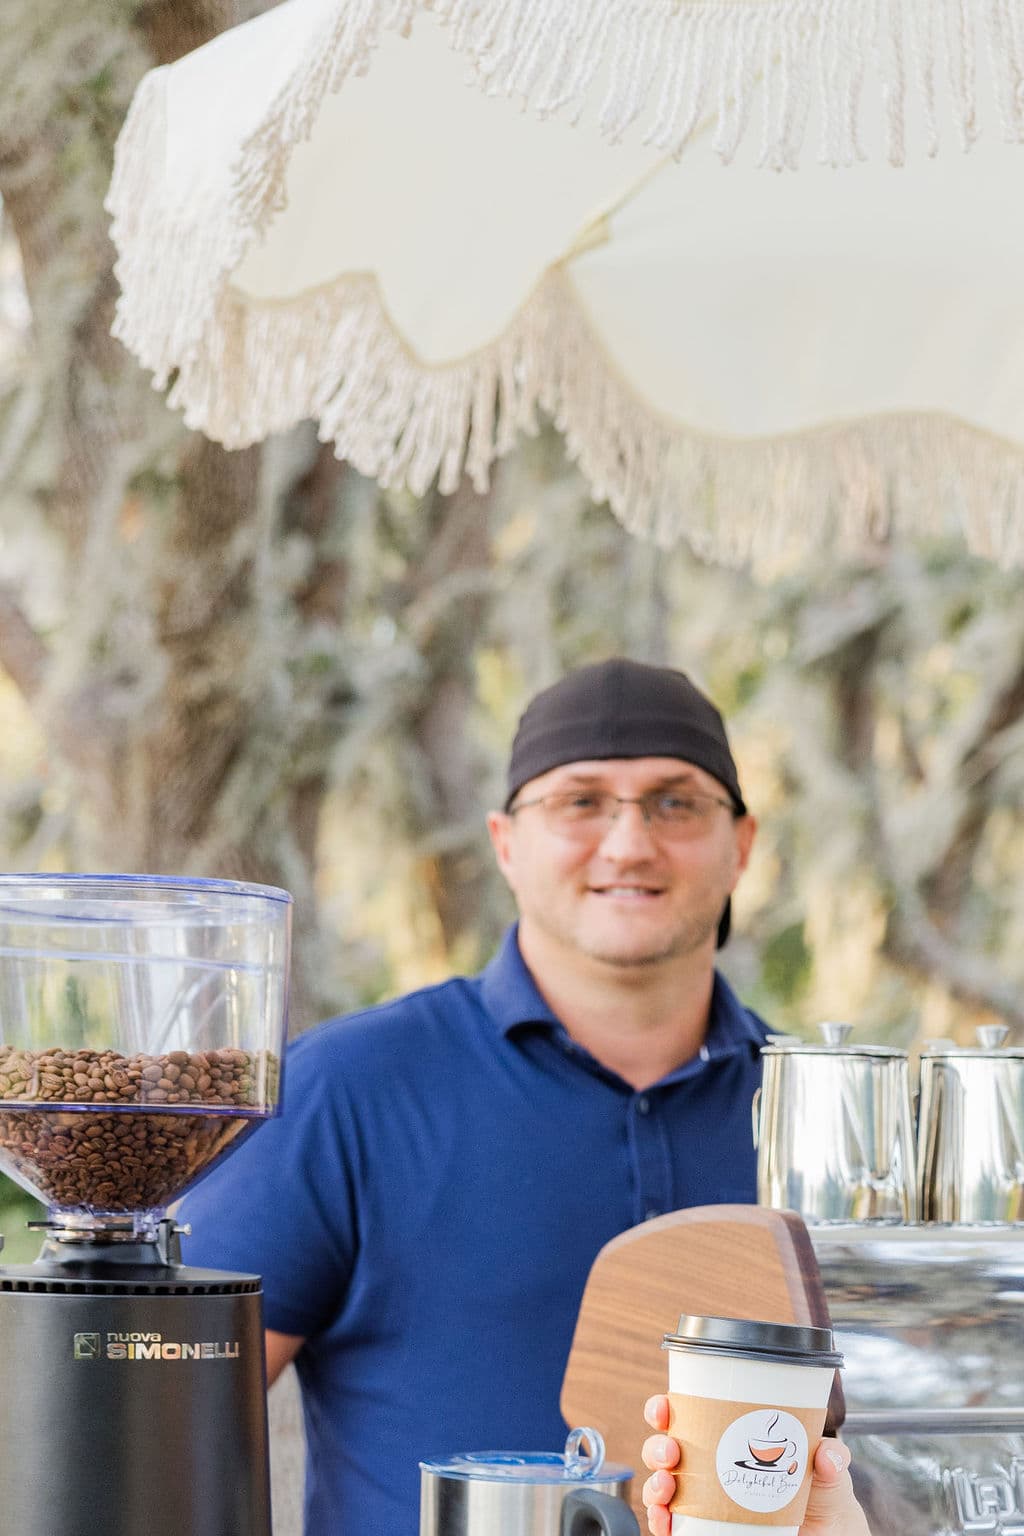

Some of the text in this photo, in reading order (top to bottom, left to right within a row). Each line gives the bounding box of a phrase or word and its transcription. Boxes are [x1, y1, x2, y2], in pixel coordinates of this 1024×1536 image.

[107, 1333, 161, 1342] nuova
[107, 1343, 239, 1360] SIMONELLI
[720, 1470, 775, 1488] Delightful
